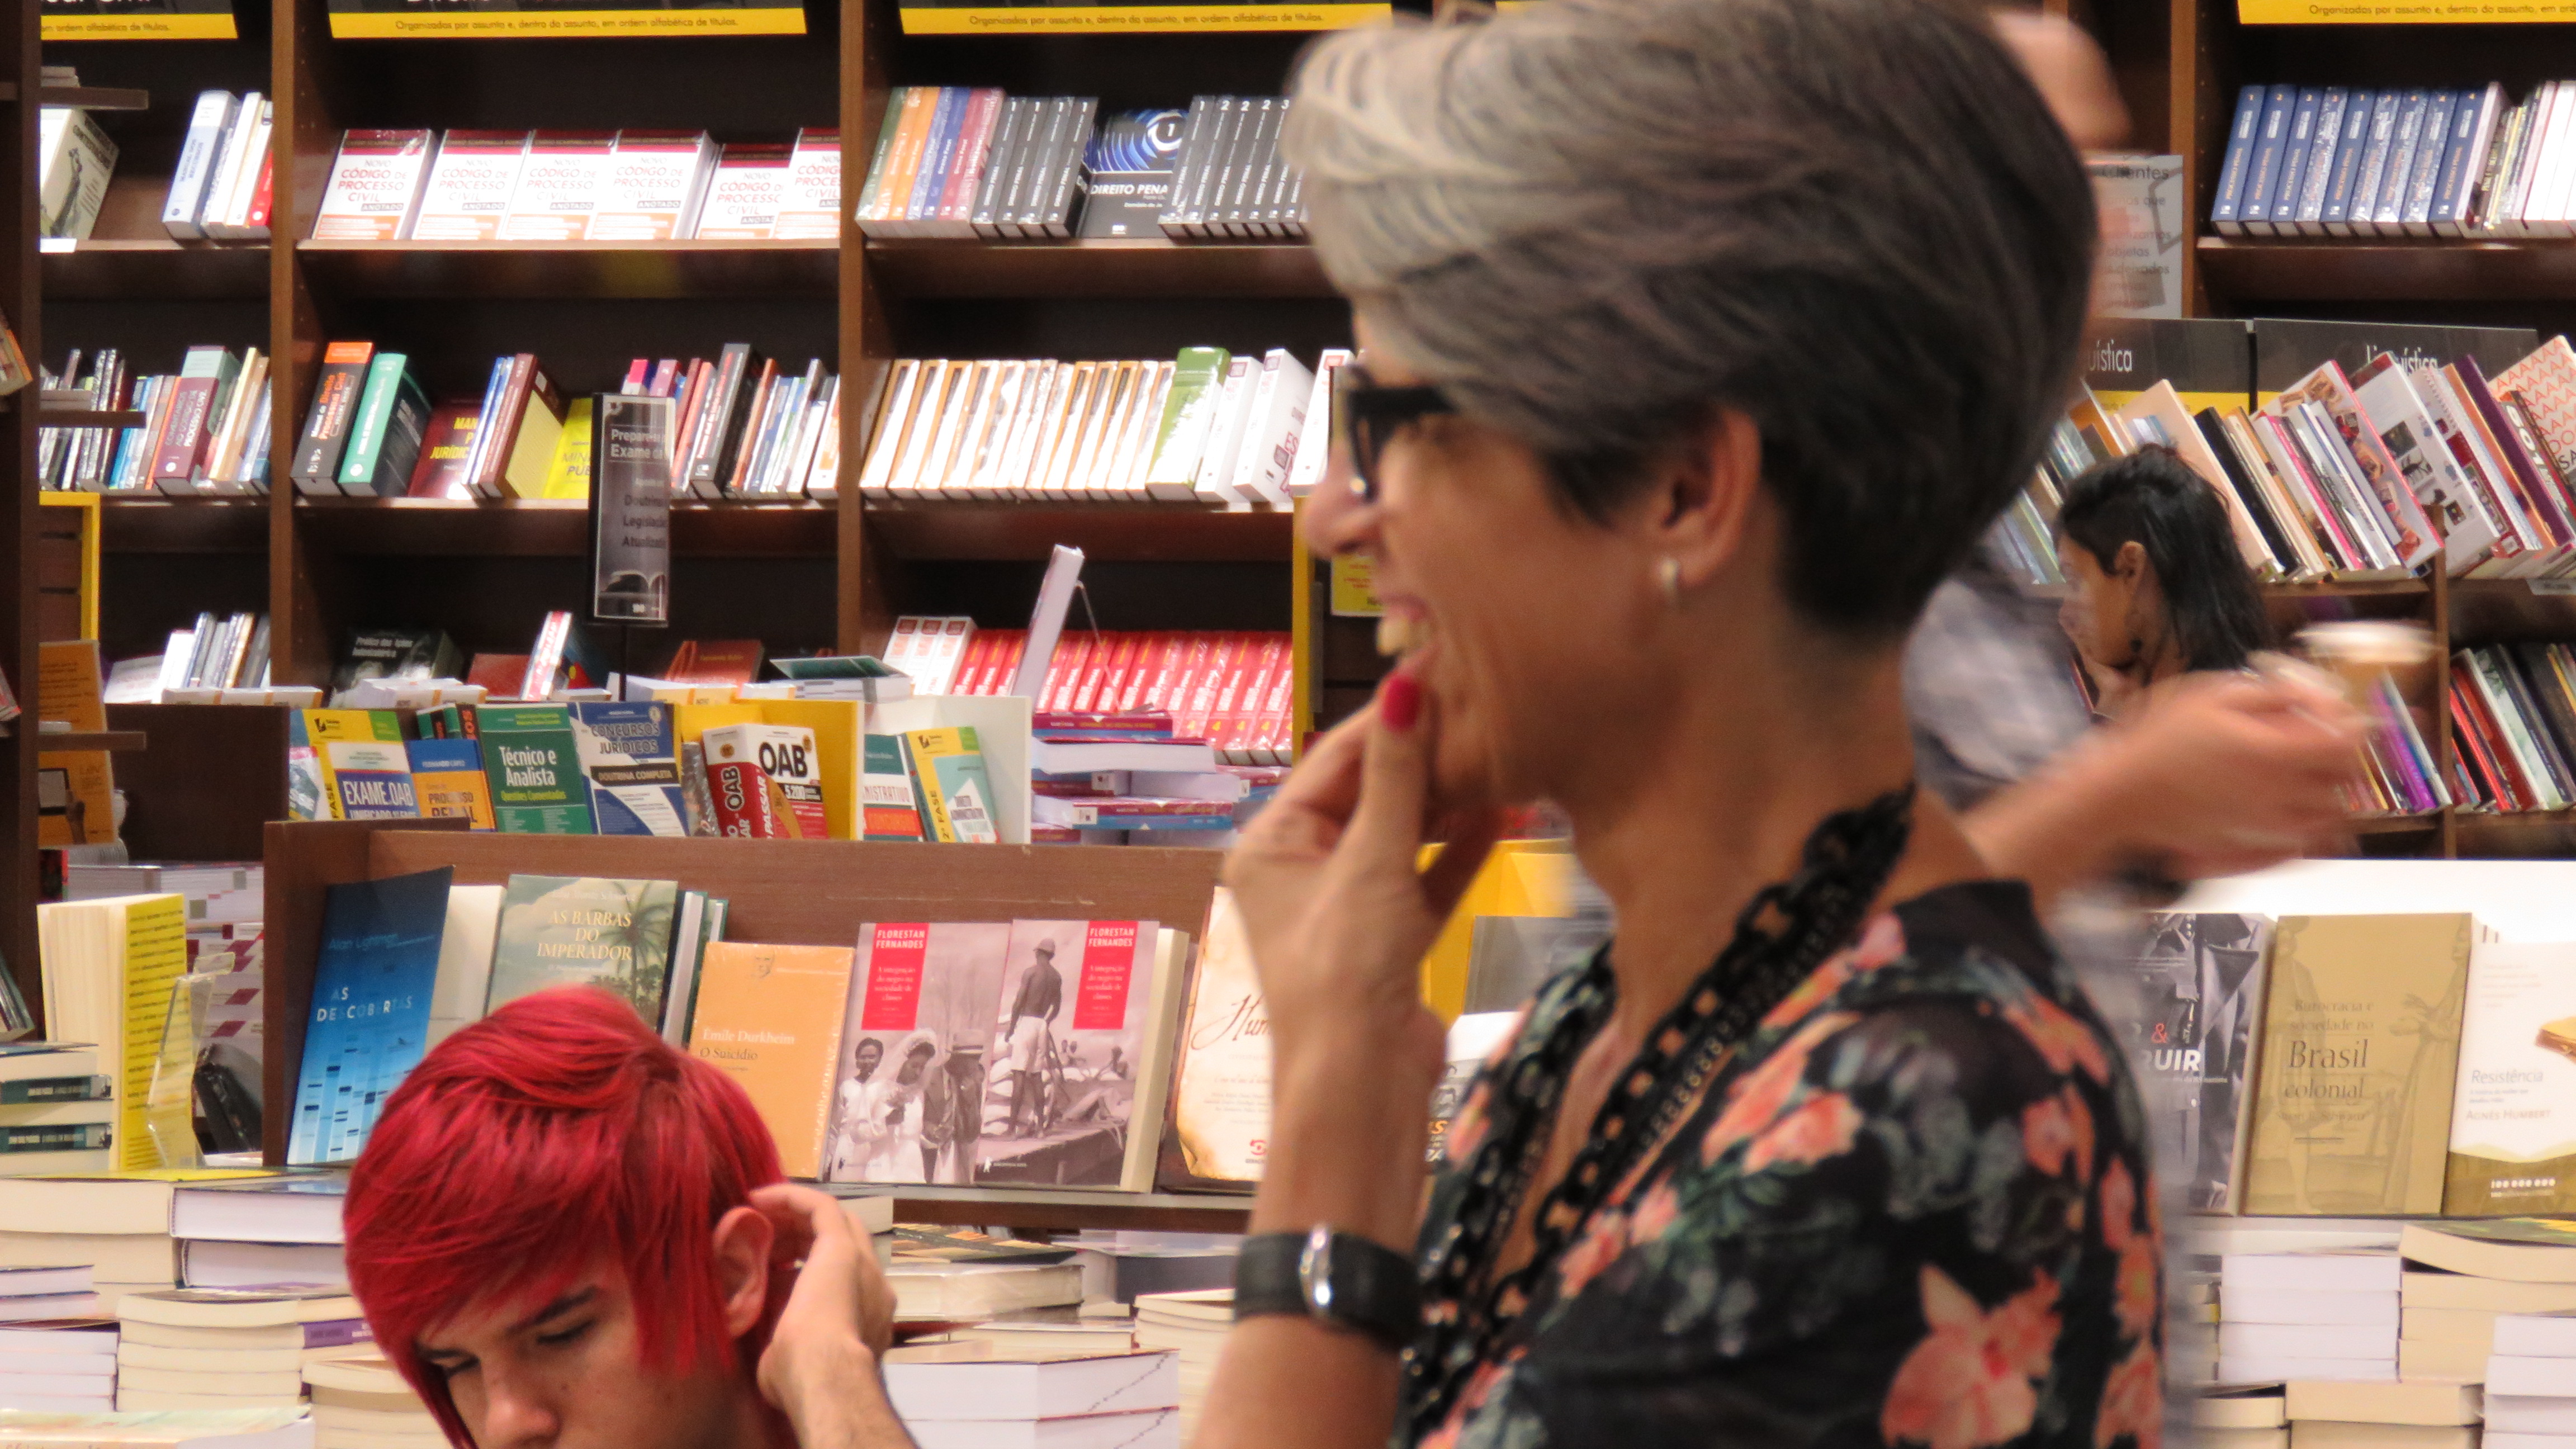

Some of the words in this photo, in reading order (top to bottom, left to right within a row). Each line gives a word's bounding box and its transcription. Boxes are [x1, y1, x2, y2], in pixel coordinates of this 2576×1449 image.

[2309, 5, 2372, 16] Organizados
[396, 21, 452, 31] Organizados
[969, 16, 1027, 27] Organizados
[1011, 102, 1017, 112] 1
[1035, 102, 1040, 112] 1
[1058, 102, 1064, 112] 1
[1082, 102, 1087, 112] 1
[1200, 101, 1205, 111] 1
[1221, 101, 1229, 110] 2
[1240, 101, 1249, 111] 2
[1261, 100, 1271, 110] 2
[1281, 100, 1289, 110] 3
[1167, 123, 1175, 136] 1
[342, 168, 391, 178] CÓDIGO
[442, 168, 491, 178] CÓDIGO
[530, 167, 580, 177] CÓDIGO
[617, 166, 666, 176] CÓDIGO
[337, 181, 404, 190] PROCESSO
[439, 181, 505, 190] PROCESSO
[527, 180, 593, 189] PROCESSO
[614, 179, 680, 188] PROCESSO
[720, 181, 770, 192] CÓDIGO
[624, 190, 656, 199] CIVIL
[806, 188, 839, 197] CIVIL
[1091, 184, 1135, 195] DIREITO
[348, 192, 380, 202] CIVIL
[449, 192, 480, 201] CIVIL
[537, 192, 569, 201] CIVIL
[727, 206, 760, 215] CIVIL
[2087, 339, 2133, 373] uística
[610, 443, 650, 458] Exame
[591, 723, 660, 737] CONCURSOS
[600, 738, 659, 755] JURÍDICOS
[499, 746, 545, 766] Técnico
[548, 751, 556, 764] e
[759, 742, 808, 778] OAB
[505, 766, 556, 787] Analista
[635, 770, 673, 780] COMPLETA
[720, 766, 745, 811] OAB
[863, 785, 911, 803] NISTRATIVO
[756, 775, 775, 836] PASSAR
[929, 790, 945, 823] FASE
[552, 910, 568, 924] AS
[572, 910, 632, 927] BARBAS
[575, 927, 600, 942] DO
[877, 930, 926, 939] FLORESTAN
[1090, 927, 1134, 937] FLORESTAN
[875, 940, 924, 949] FERNANDES
[1088, 937, 1133, 947] FERNANDES
[537, 943, 633, 960] IMPERADOR
[702, 1027, 735, 1042] Émile
[738, 1030, 795, 1045] Durkheim
[699, 1046, 711, 1058] O
[713, 1048, 759, 1060] Suicídio
[2289, 1038, 2369, 1069] Brasil
[2142, 1048, 2201, 1072] UIR
[2471, 1068, 2544, 1085] Resistência
[2284, 1077, 2364, 1100] colonial
